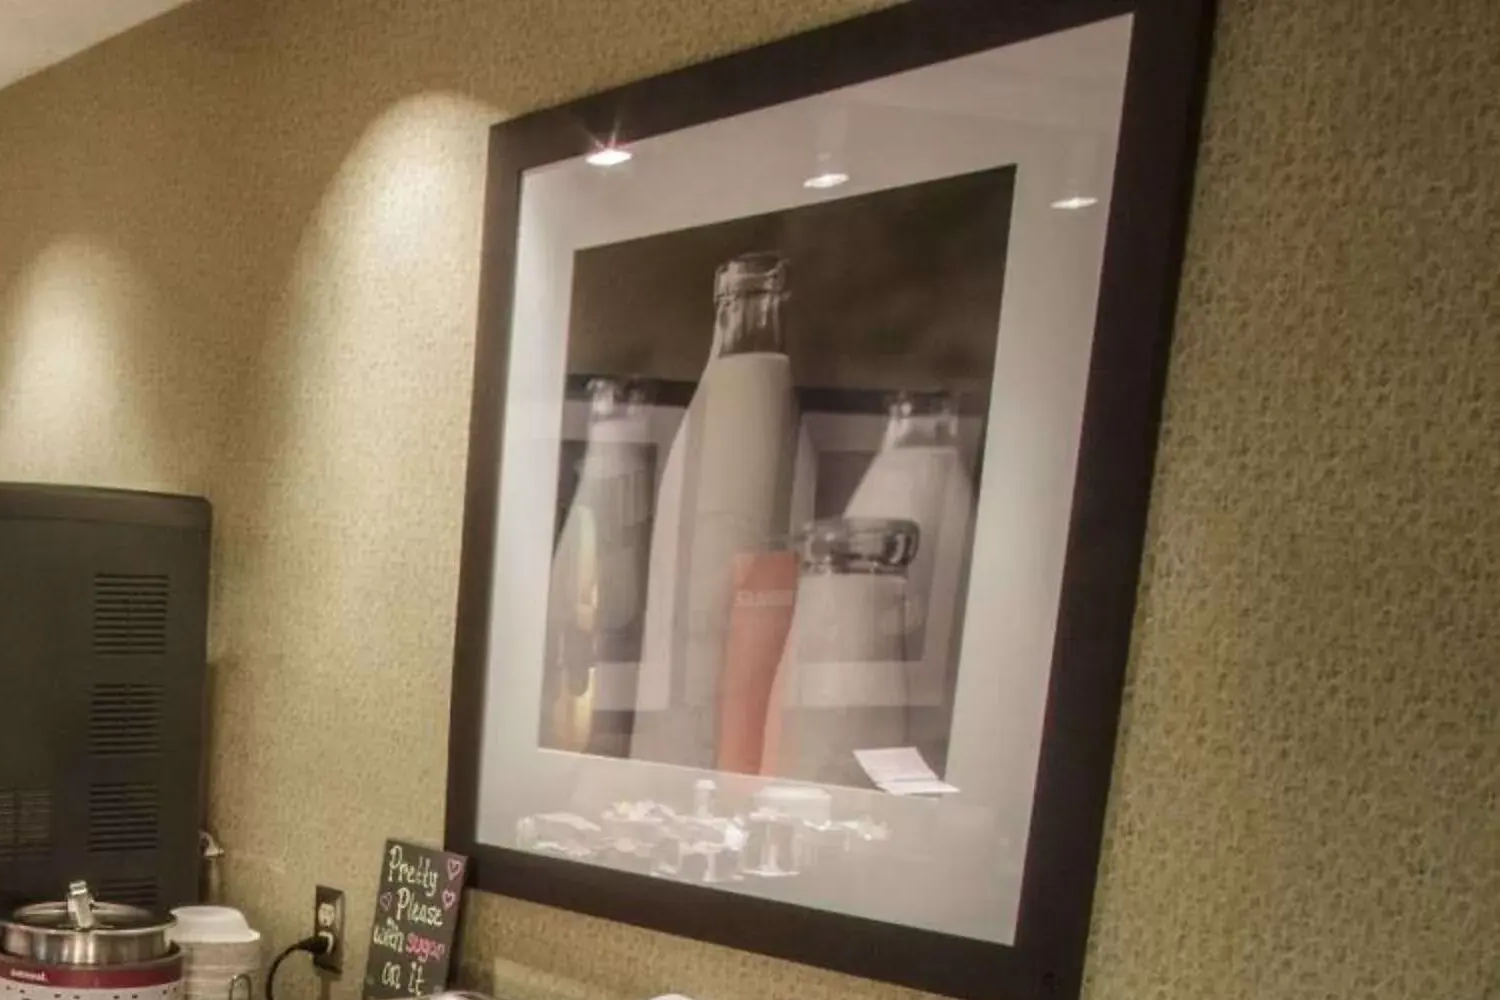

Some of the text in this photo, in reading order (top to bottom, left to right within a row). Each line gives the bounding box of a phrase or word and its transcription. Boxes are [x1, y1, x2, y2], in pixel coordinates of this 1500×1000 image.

[387, 844, 439, 897] Pretty
[395, 886, 444, 927] Please
[373, 916, 446, 963] with sugar
[381, 961, 402, 990] on
